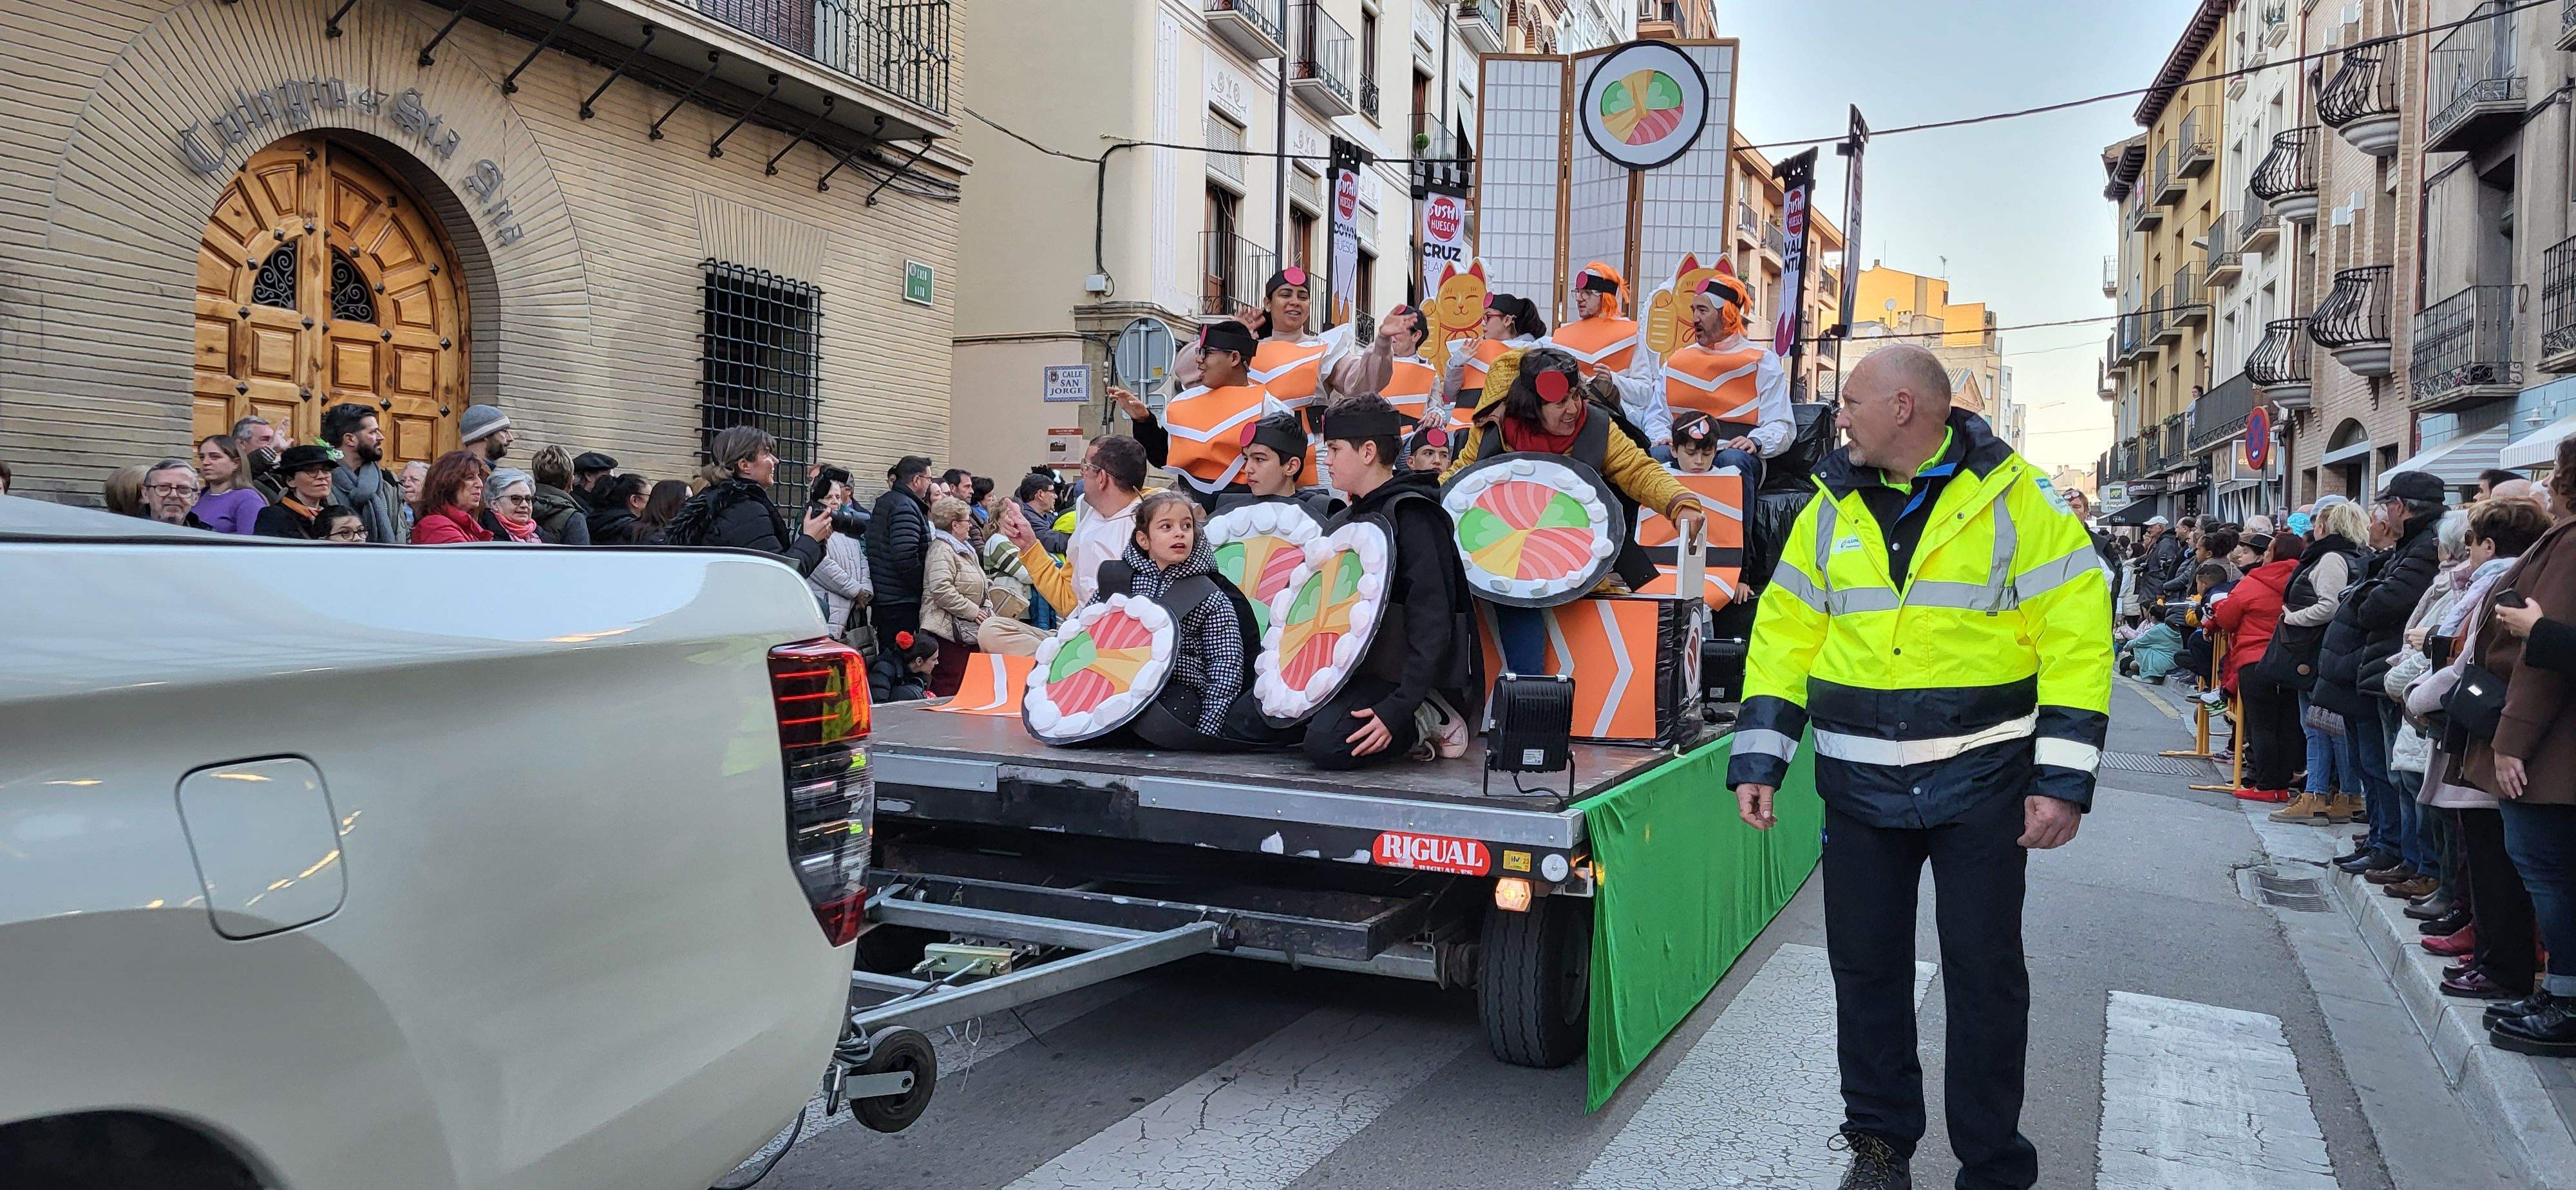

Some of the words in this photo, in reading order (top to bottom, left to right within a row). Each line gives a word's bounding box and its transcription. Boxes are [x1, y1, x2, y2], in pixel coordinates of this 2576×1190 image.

[181, 75, 348, 172] Colegio
[1339, 180, 1356, 197] SUSHI
[1340, 196, 1354, 209] HUESCA
[1429, 204, 1459, 221] SUSHI
[1431, 219, 1455, 232] HUESCA
[1788, 213, 1803, 230] HUESCA
[1334, 221, 1357, 241] DOWN
[1334, 239, 1357, 254] HUESCA
[1423, 241, 1461, 262] CRUZ
[1050, 387, 1083, 396] JORGE
[1381, 834, 1483, 867] RIGUAL
